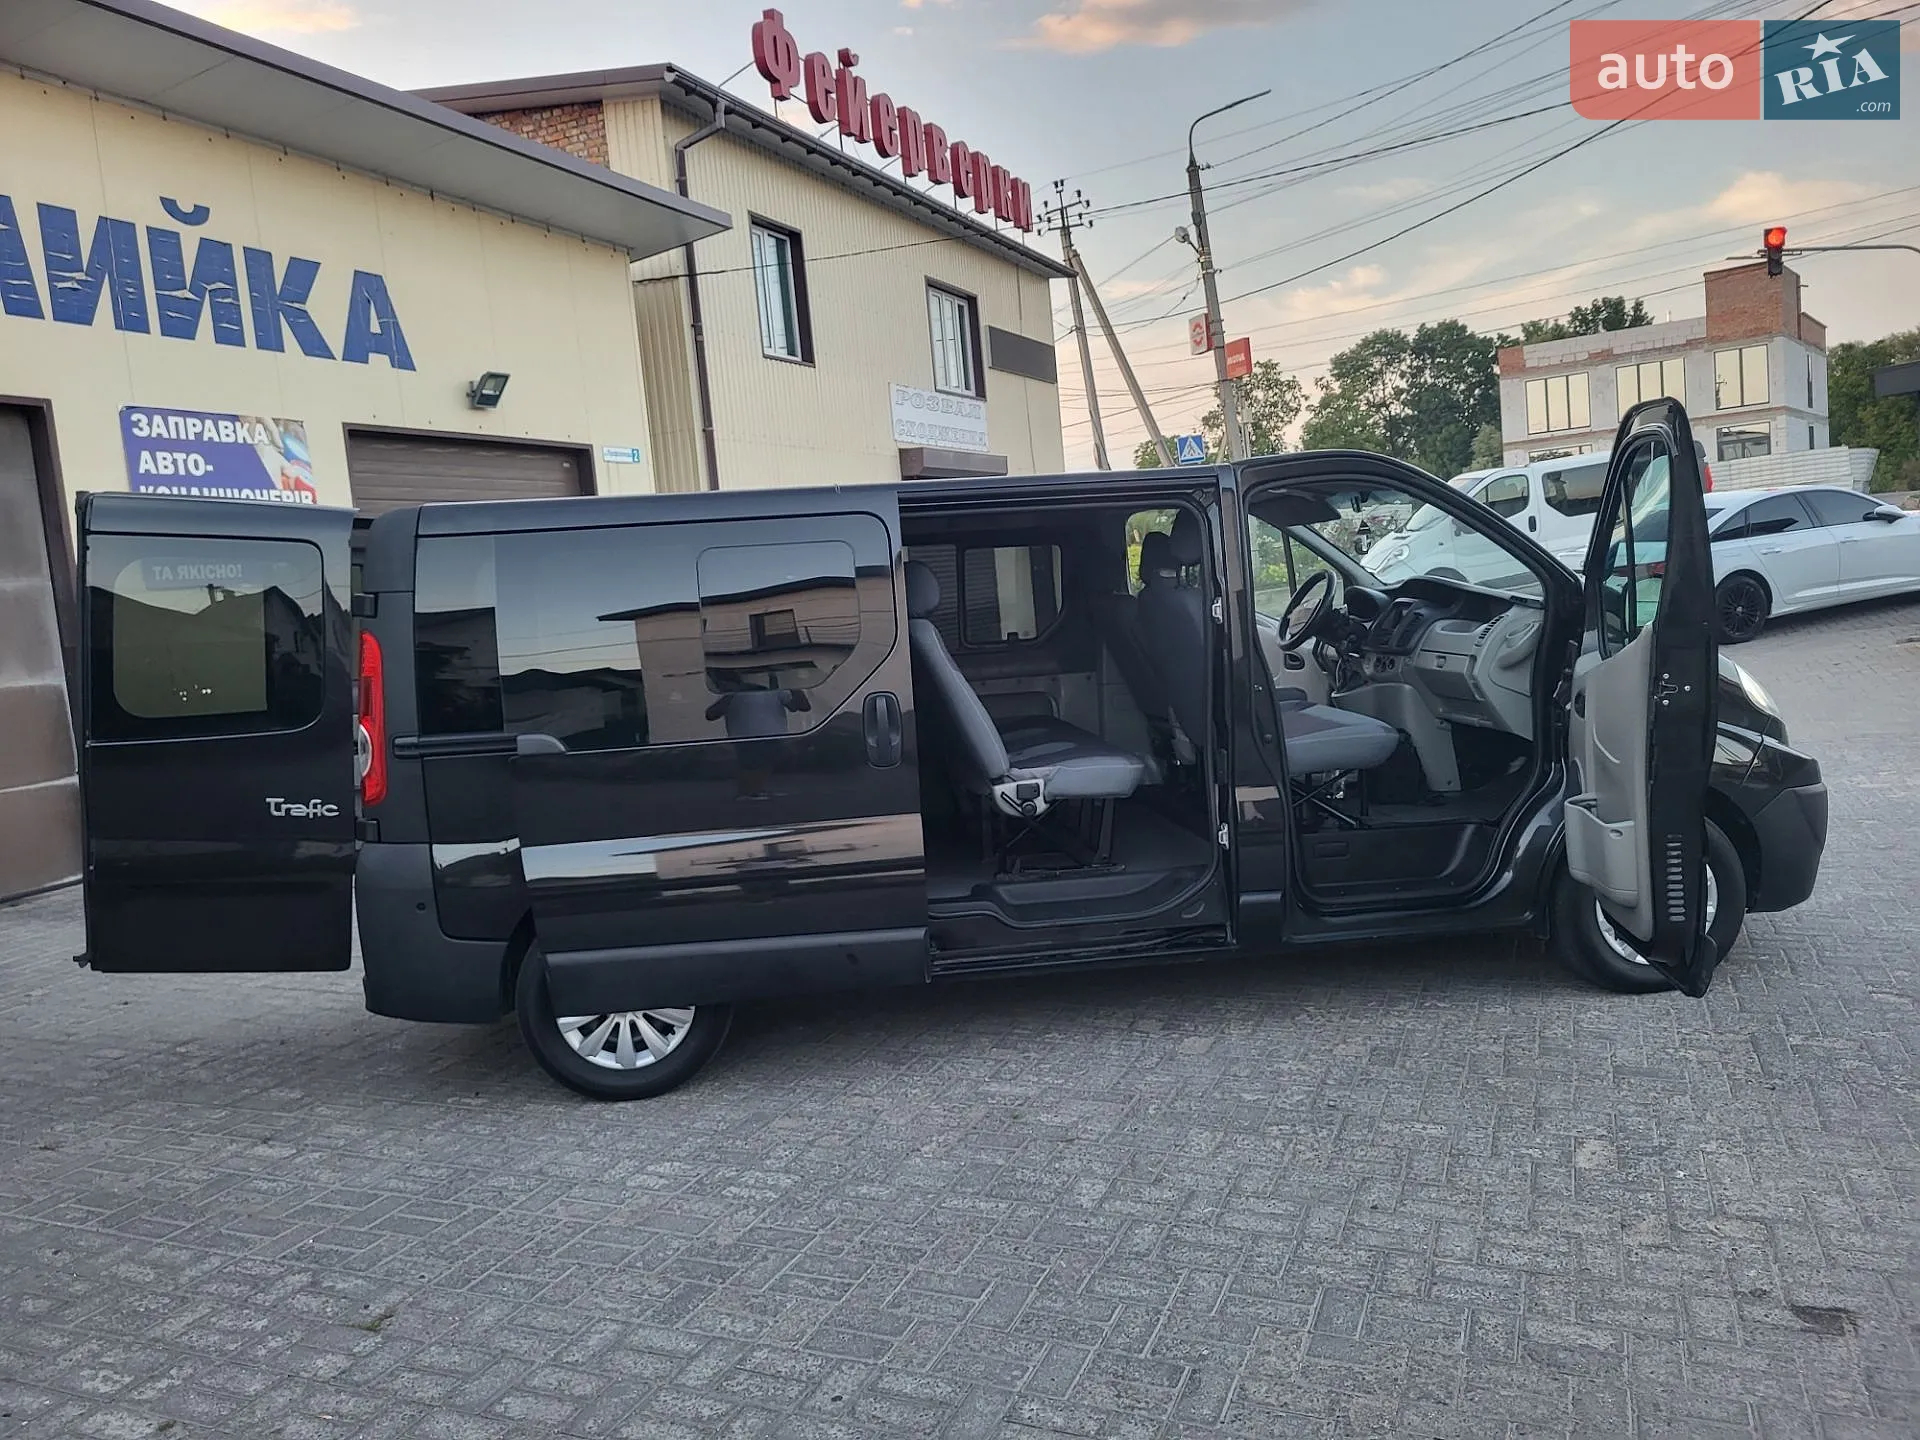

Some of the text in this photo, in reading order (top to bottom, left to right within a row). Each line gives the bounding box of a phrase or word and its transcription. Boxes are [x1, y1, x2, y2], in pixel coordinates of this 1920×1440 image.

[752, 8, 1033, 233] Фейерверки
[130, 412, 270, 445] ЗАПРАВКА
[138, 450, 214, 477] АВТО-
[265, 797, 340, 819] Trafic
